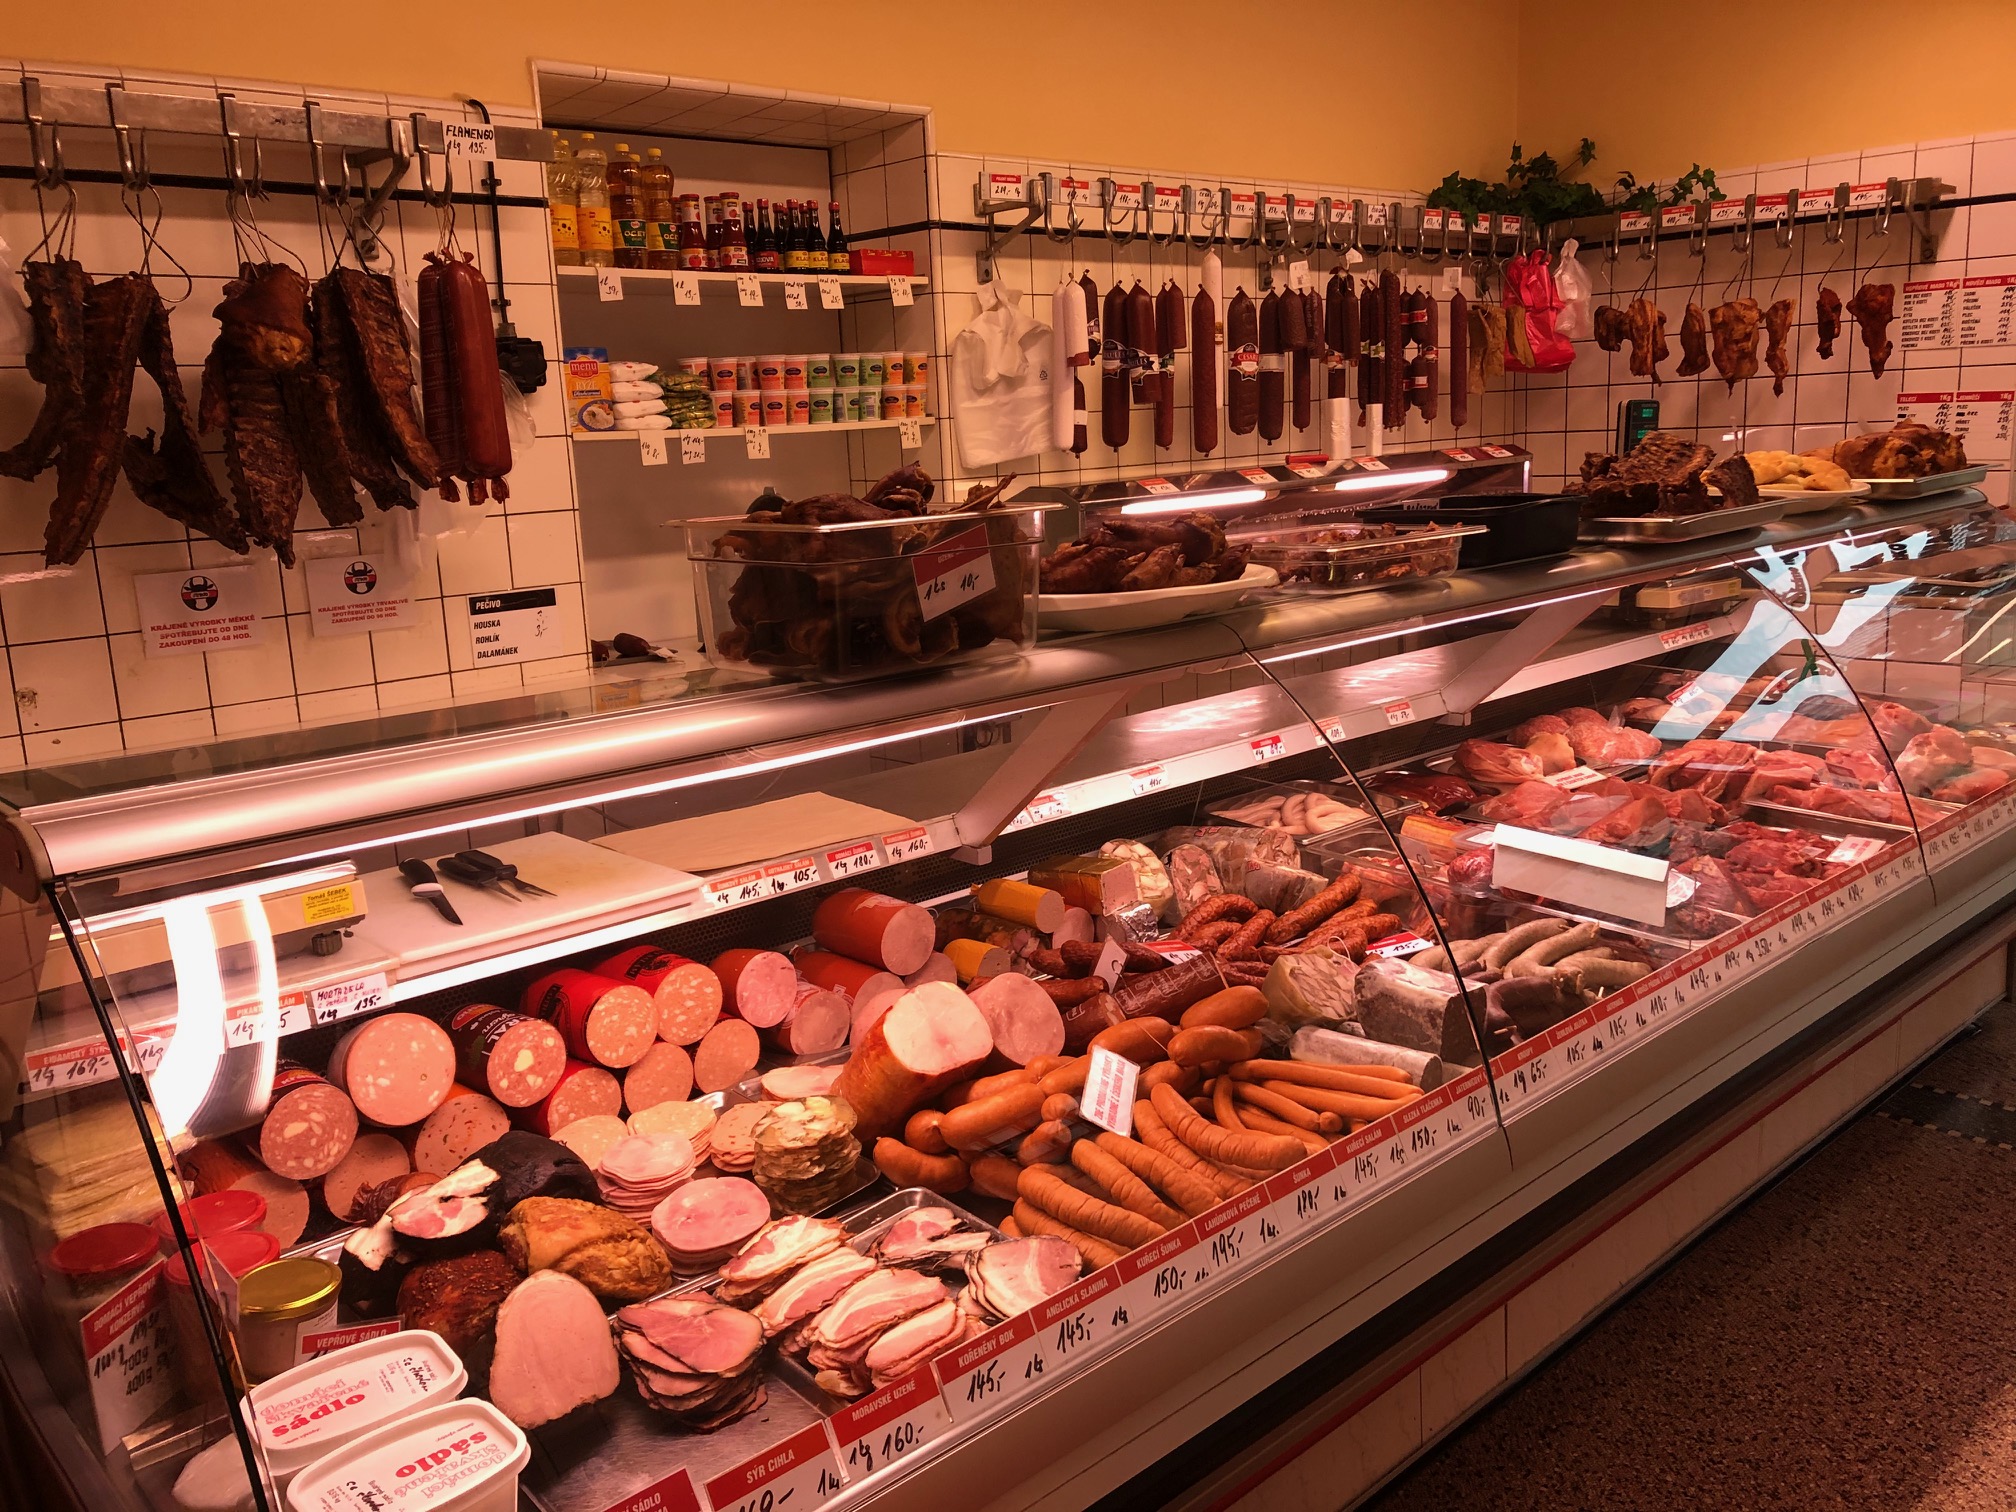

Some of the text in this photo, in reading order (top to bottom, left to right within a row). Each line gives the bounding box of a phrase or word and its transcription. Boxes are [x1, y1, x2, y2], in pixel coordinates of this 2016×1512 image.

[446, 125, 494, 140] FLAMENGO
[571, 362, 598, 371] menu
[475, 597, 501, 610] PEČIVO
[150, 614, 256, 632] KRÁJENÉ VÝROBKY MĚKKÉ
[160, 628, 218, 640] SPOTŘEBUJTE
[232, 624, 249, 632] DNE
[474, 620, 501, 630] HOUSKA
[159, 636, 206, 649] ZAKOUPENÍ
[476, 633, 500, 645] ROHLÍK
[477, 646, 518, 660] DALAMÁNEK
[908, 838, 928, 852] 160,-
[854, 854, 874, 868] 180,-
[740, 882, 762, 900] 145,-
[1364, 1129, 1382, 1144] SALÁM
[1412, 1126, 1438, 1154] 150,-
[1292, 1166, 1312, 1184] ŠUNKA
[1354, 1152, 1380, 1184] 145,-
[1204, 1206, 1239, 1232] LAHŮDKOVÁ
[1136, 1238, 1182, 1270] KUŘECÍ ŠUNKA
[1212, 1228, 1244, 1268] 195,-
[1154, 1266, 1187, 1298] 150,-
[1046, 1276, 1109, 1320] ANGLICKÁ SLANINA
[93, 1303, 122, 1332] DOMÁCÍ
[316, 1333, 358, 1350] VEPŘOVÉ
[1056, 1312, 1094, 1354] 145,-
[958, 1328, 1015, 1369] KOŘENĚNÝ BOK
[966, 1360, 1006, 1403] 145,-
[260, 1378, 346, 1416] domácí
[850, 1378, 917, 1423] MORAVSKÉ UZENÉ
[272, 1394, 366, 1438] sádlo
[396, 1431, 488, 1478] sádlo
[882, 1420, 925, 1461] 160,-
[394, 1443, 500, 1498] škvařené
[421, 1450, 506, 1498] domácí
[746, 1448, 796, 1484] SÝR CIHLA
